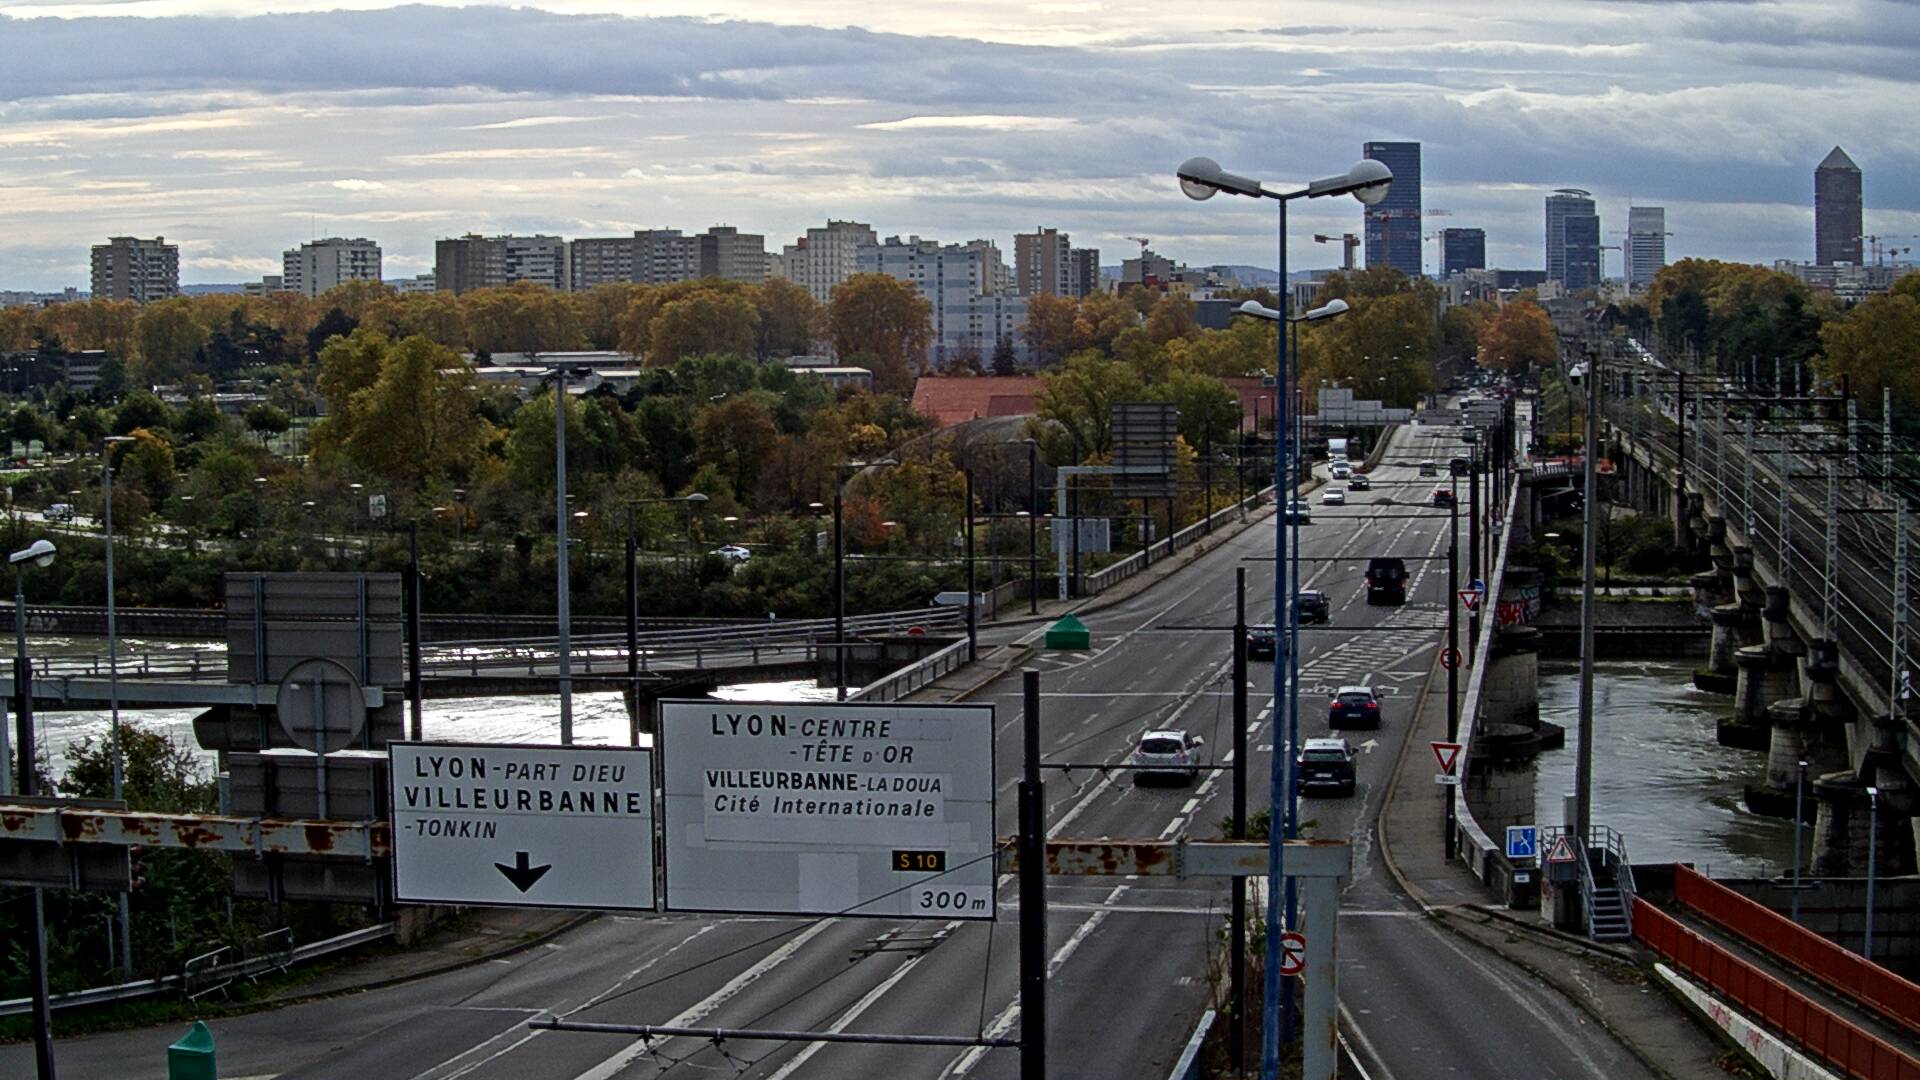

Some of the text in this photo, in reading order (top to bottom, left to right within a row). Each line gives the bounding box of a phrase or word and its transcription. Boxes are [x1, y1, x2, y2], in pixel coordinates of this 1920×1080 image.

[712, 713, 891, 738] LYON-CENTRE
[415, 756, 626, 782] LYON-PART DIEU
[892, 777, 942, 793] DOUA
[404, 786, 641, 814] VILLEURBANNE
[714, 794, 935, 817] Cité Internationale
[900, 853, 937, 869] S 10
